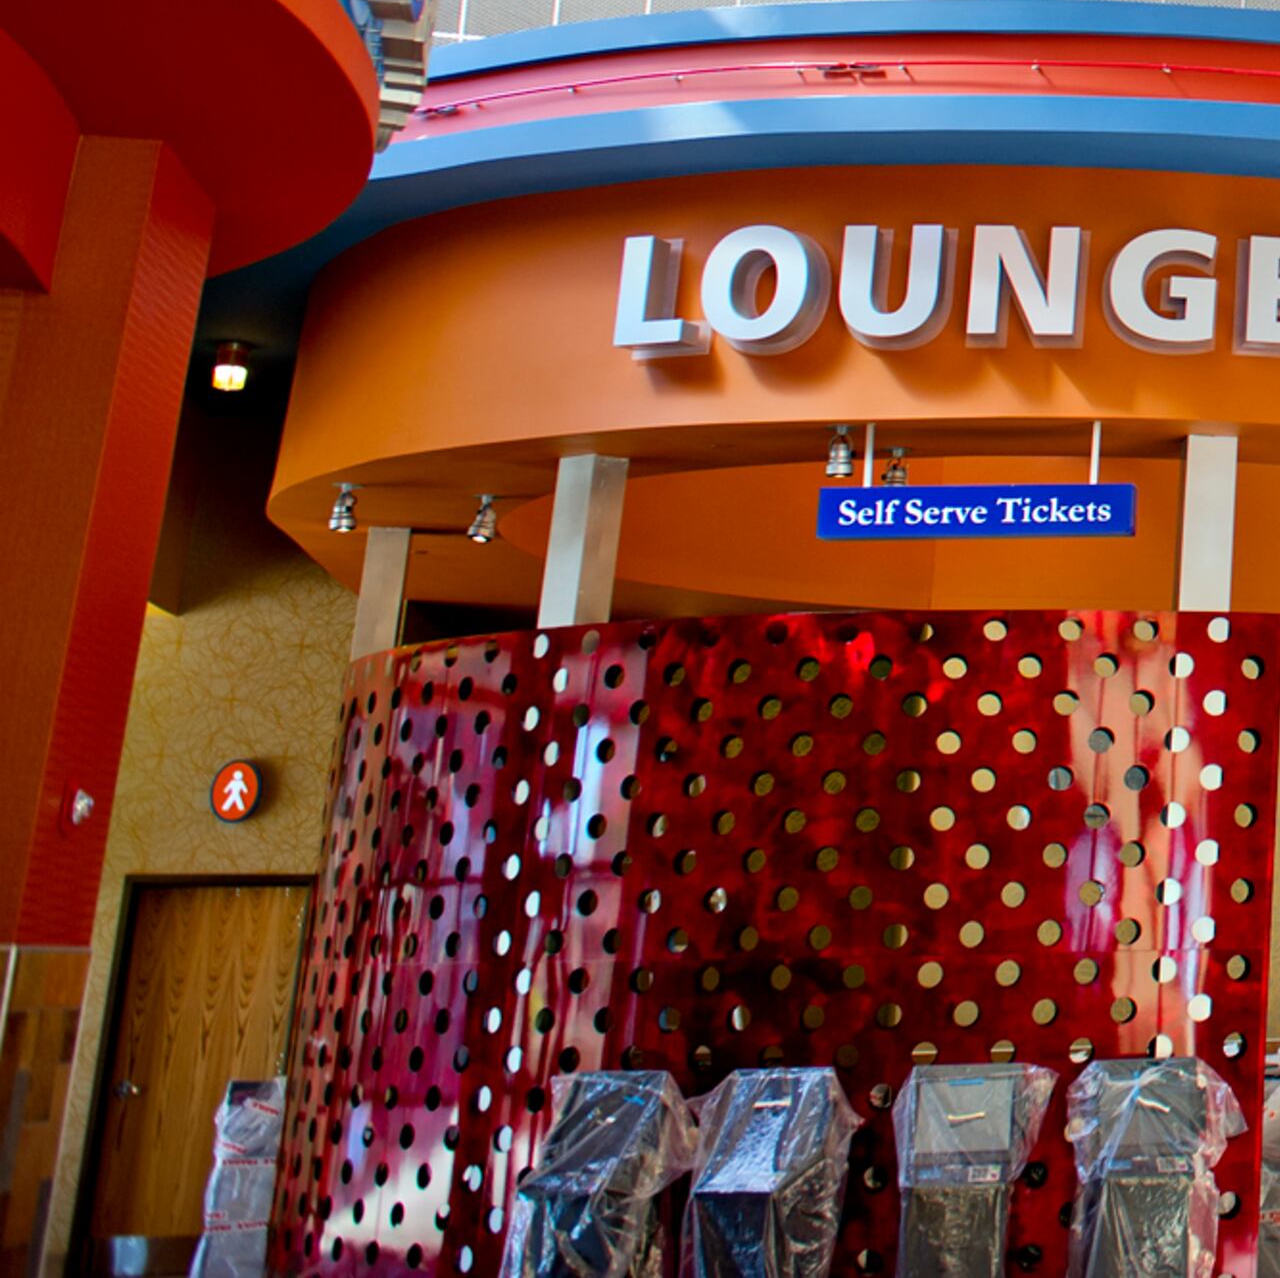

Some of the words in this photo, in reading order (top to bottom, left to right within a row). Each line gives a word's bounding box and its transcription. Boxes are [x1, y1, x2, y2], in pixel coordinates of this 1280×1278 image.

[838, 499, 901, 526] Self
[904, 498, 988, 525] Serve
[996, 497, 1112, 524] Tickets
